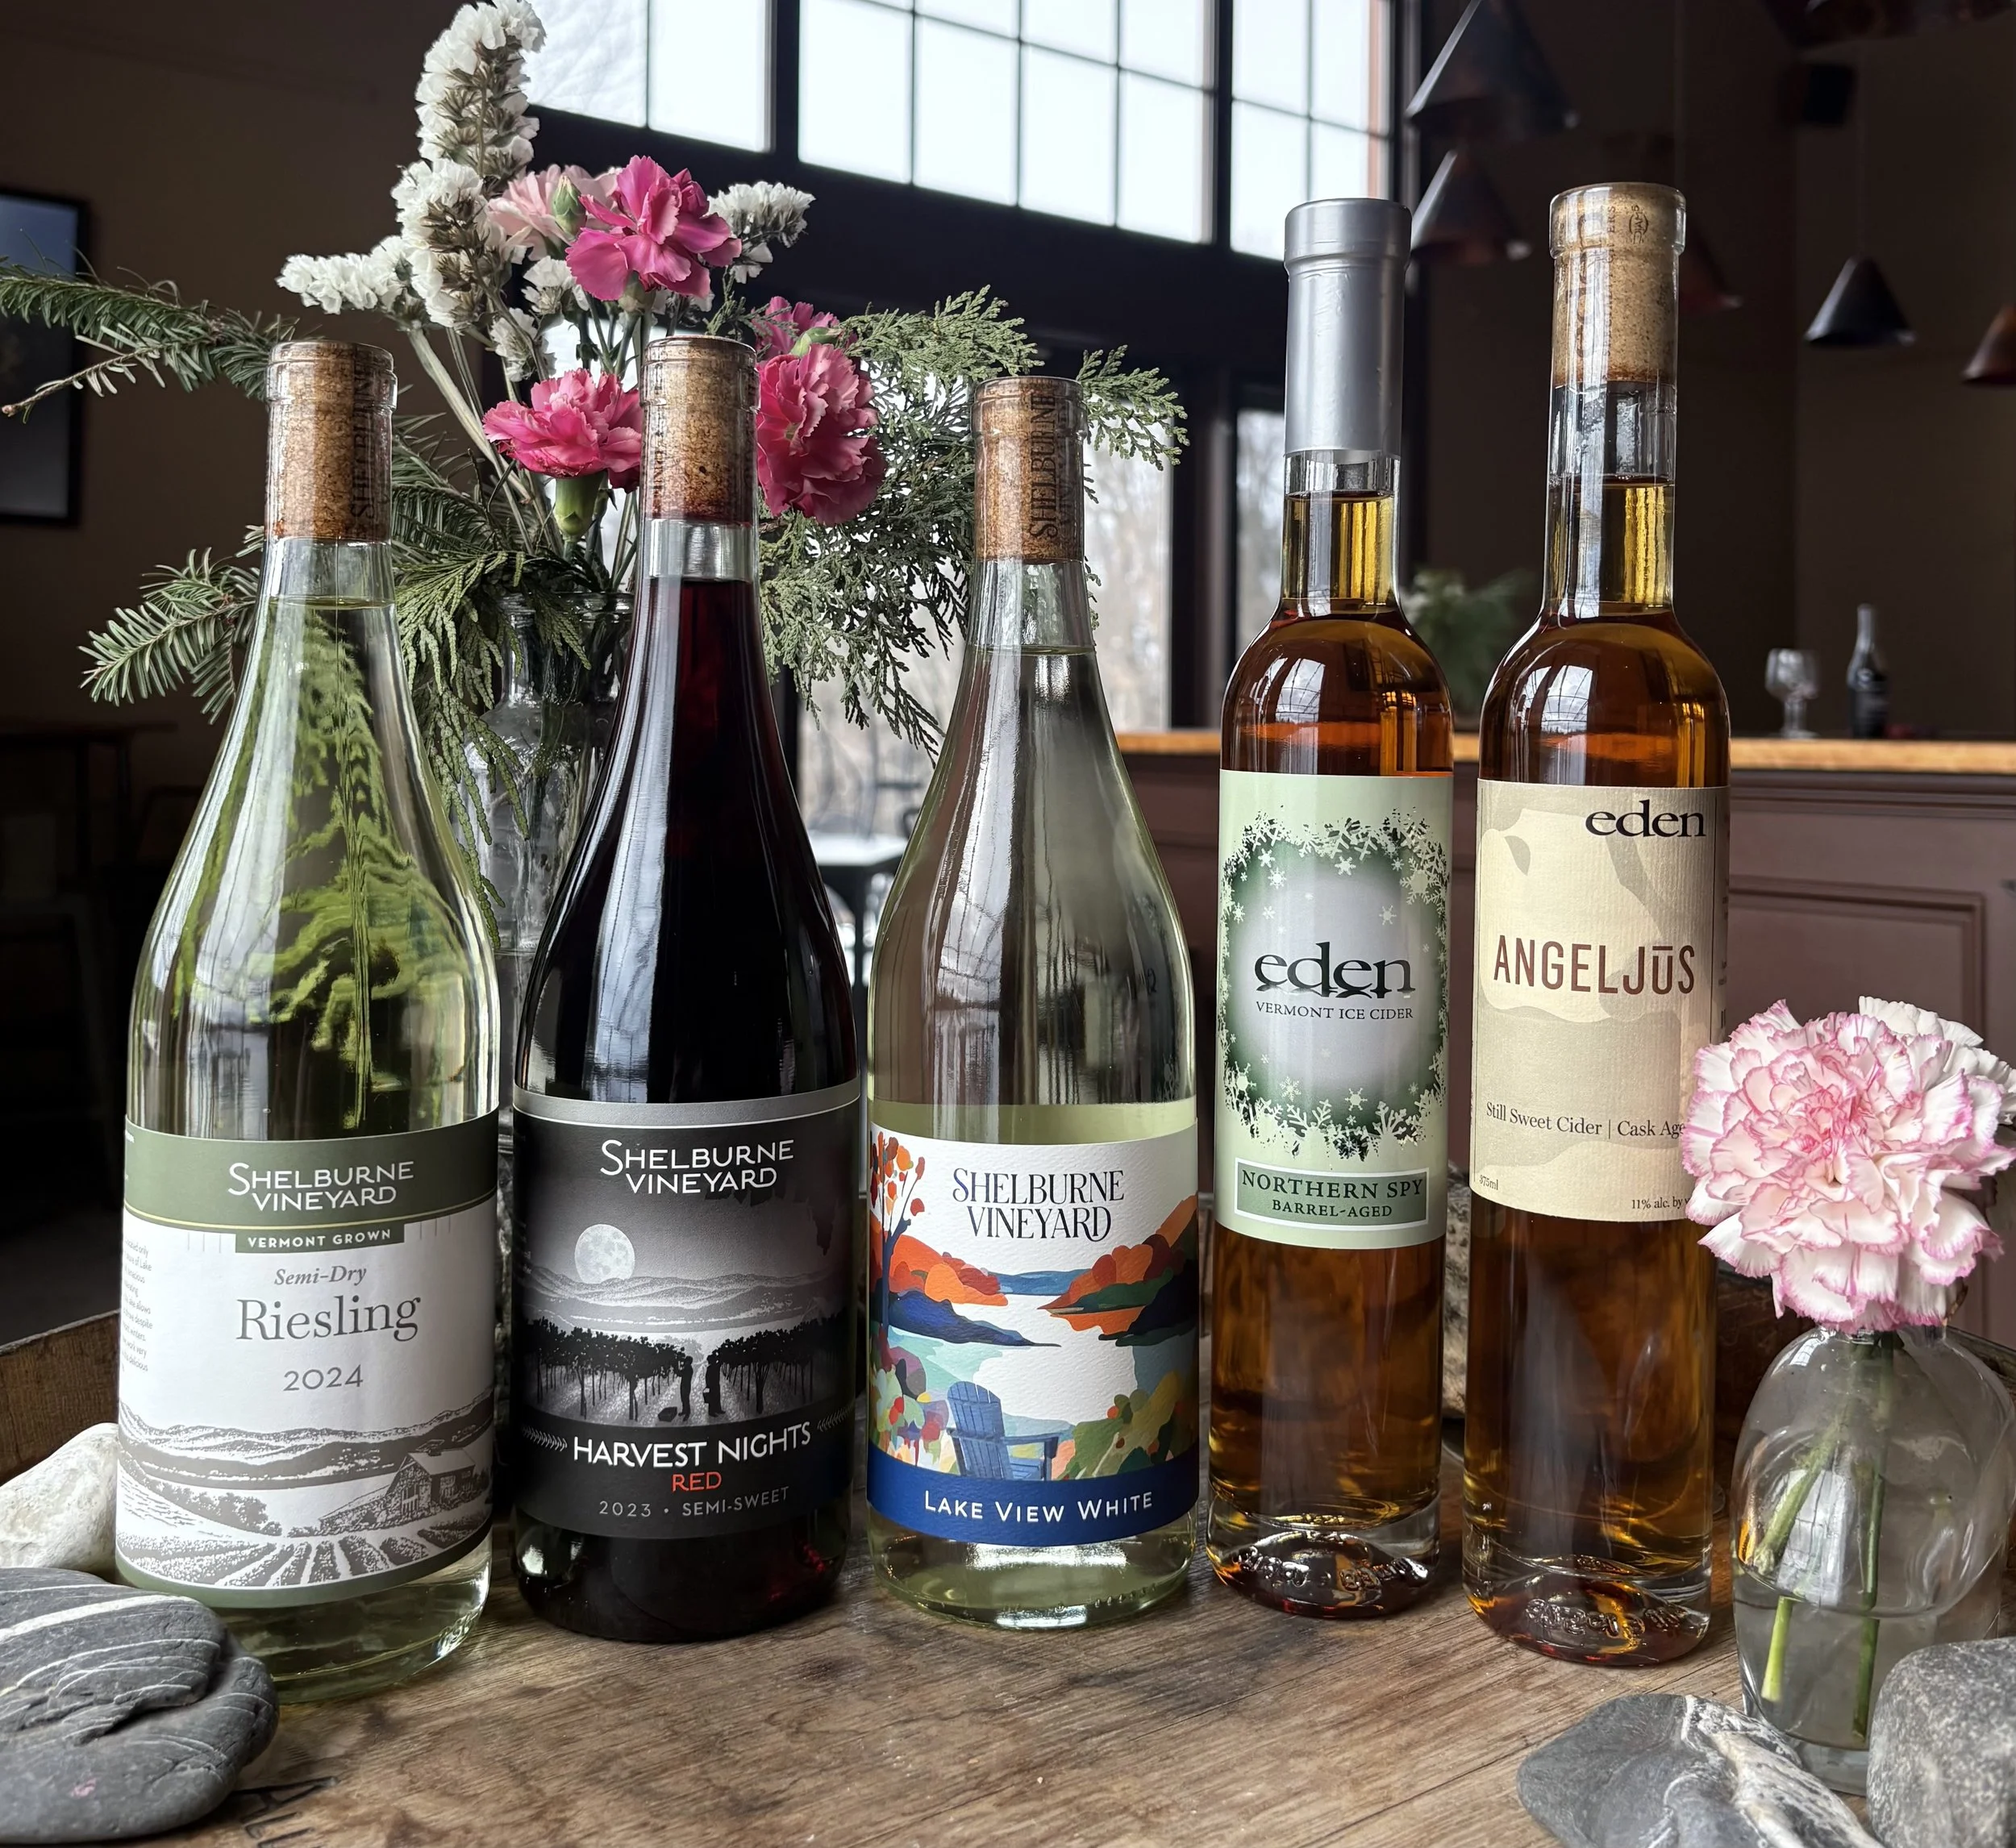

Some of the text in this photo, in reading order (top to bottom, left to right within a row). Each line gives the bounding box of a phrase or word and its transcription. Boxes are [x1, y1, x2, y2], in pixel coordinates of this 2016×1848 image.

[1585, 799, 1706, 839] eden
[1254, 941, 1416, 999] eden
[1256, 1001, 1414, 1020] VERMONT ICE CIDER
[1486, 1101, 1685, 1139] Still Sweet Cider Cask Age
[600, 1138, 794, 1176] SHELBURNE
[228, 1160, 414, 1196] SHELBURNE
[625, 1167, 777, 1195] VINEYARD
[952, 1167, 1125, 1206] SHELBURNE
[1242, 1168, 1424, 1201] NORTHERN SPY
[1479, 1174, 1499, 1191] 375ml
[252, 1185, 397, 1212] VINEYARD
[1272, 1198, 1393, 1217] BARREL-AGED
[1631, 1198, 1652, 1210] 11%
[1654, 1197, 1670, 1209] alc.
[1672, 1196, 1684, 1209] by
[248, 1228, 391, 1248] VERMONT GROWN
[966, 1205, 1112, 1242] VINEYARD
[274, 1265, 367, 1287] Semi-Dry
[236, 1295, 421, 1342] Riesling
[283, 1364, 364, 1392] 2024
[573, 1421, 811, 1468] HARVEST NIGHTS
[672, 1471, 722, 1492] RED
[598, 1485, 789, 1518] 2023 SEMI-SWEET
[924, 1490, 1153, 1523] LAKE VIEW WHITE
